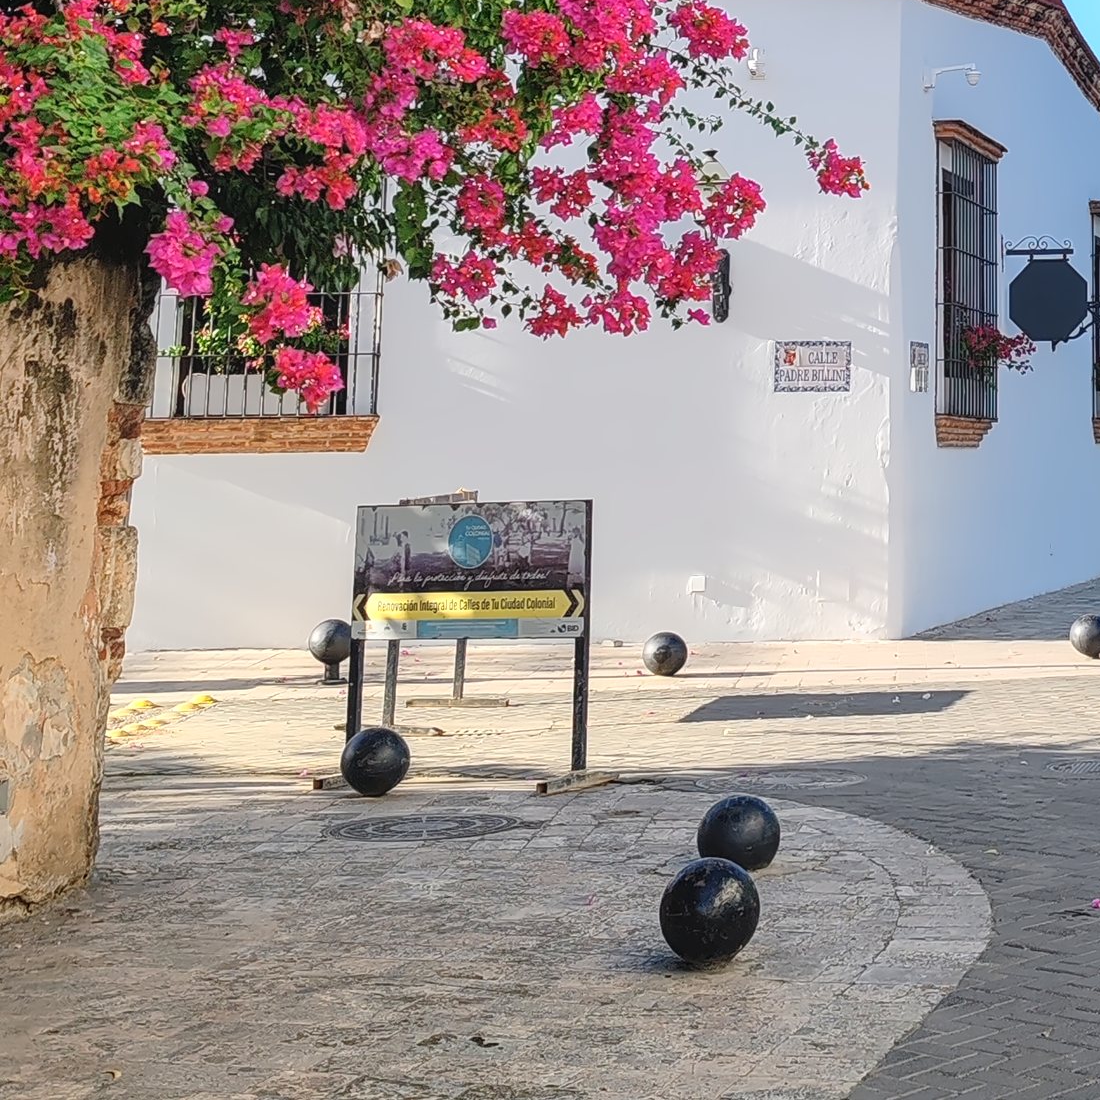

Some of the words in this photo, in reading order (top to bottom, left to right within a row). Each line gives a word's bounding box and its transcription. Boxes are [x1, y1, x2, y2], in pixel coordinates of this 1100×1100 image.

[808, 351, 839, 364] CALLE
[779, 368, 810, 382] PADRE
[811, 368, 846, 382] BILLINI
[464, 573, 474, 591] y
[509, 569, 520, 580] de
[377, 599, 418, 613] Renovación
[419, 599, 448, 614] Integral
[449, 599, 458, 610] de
[459, 598, 480, 611] Calles
[481, 598, 490, 610] de
[491, 598, 499, 610] Tu
[500, 597, 525, 610] Ciudad
[526, 597, 556, 610] Colonial
